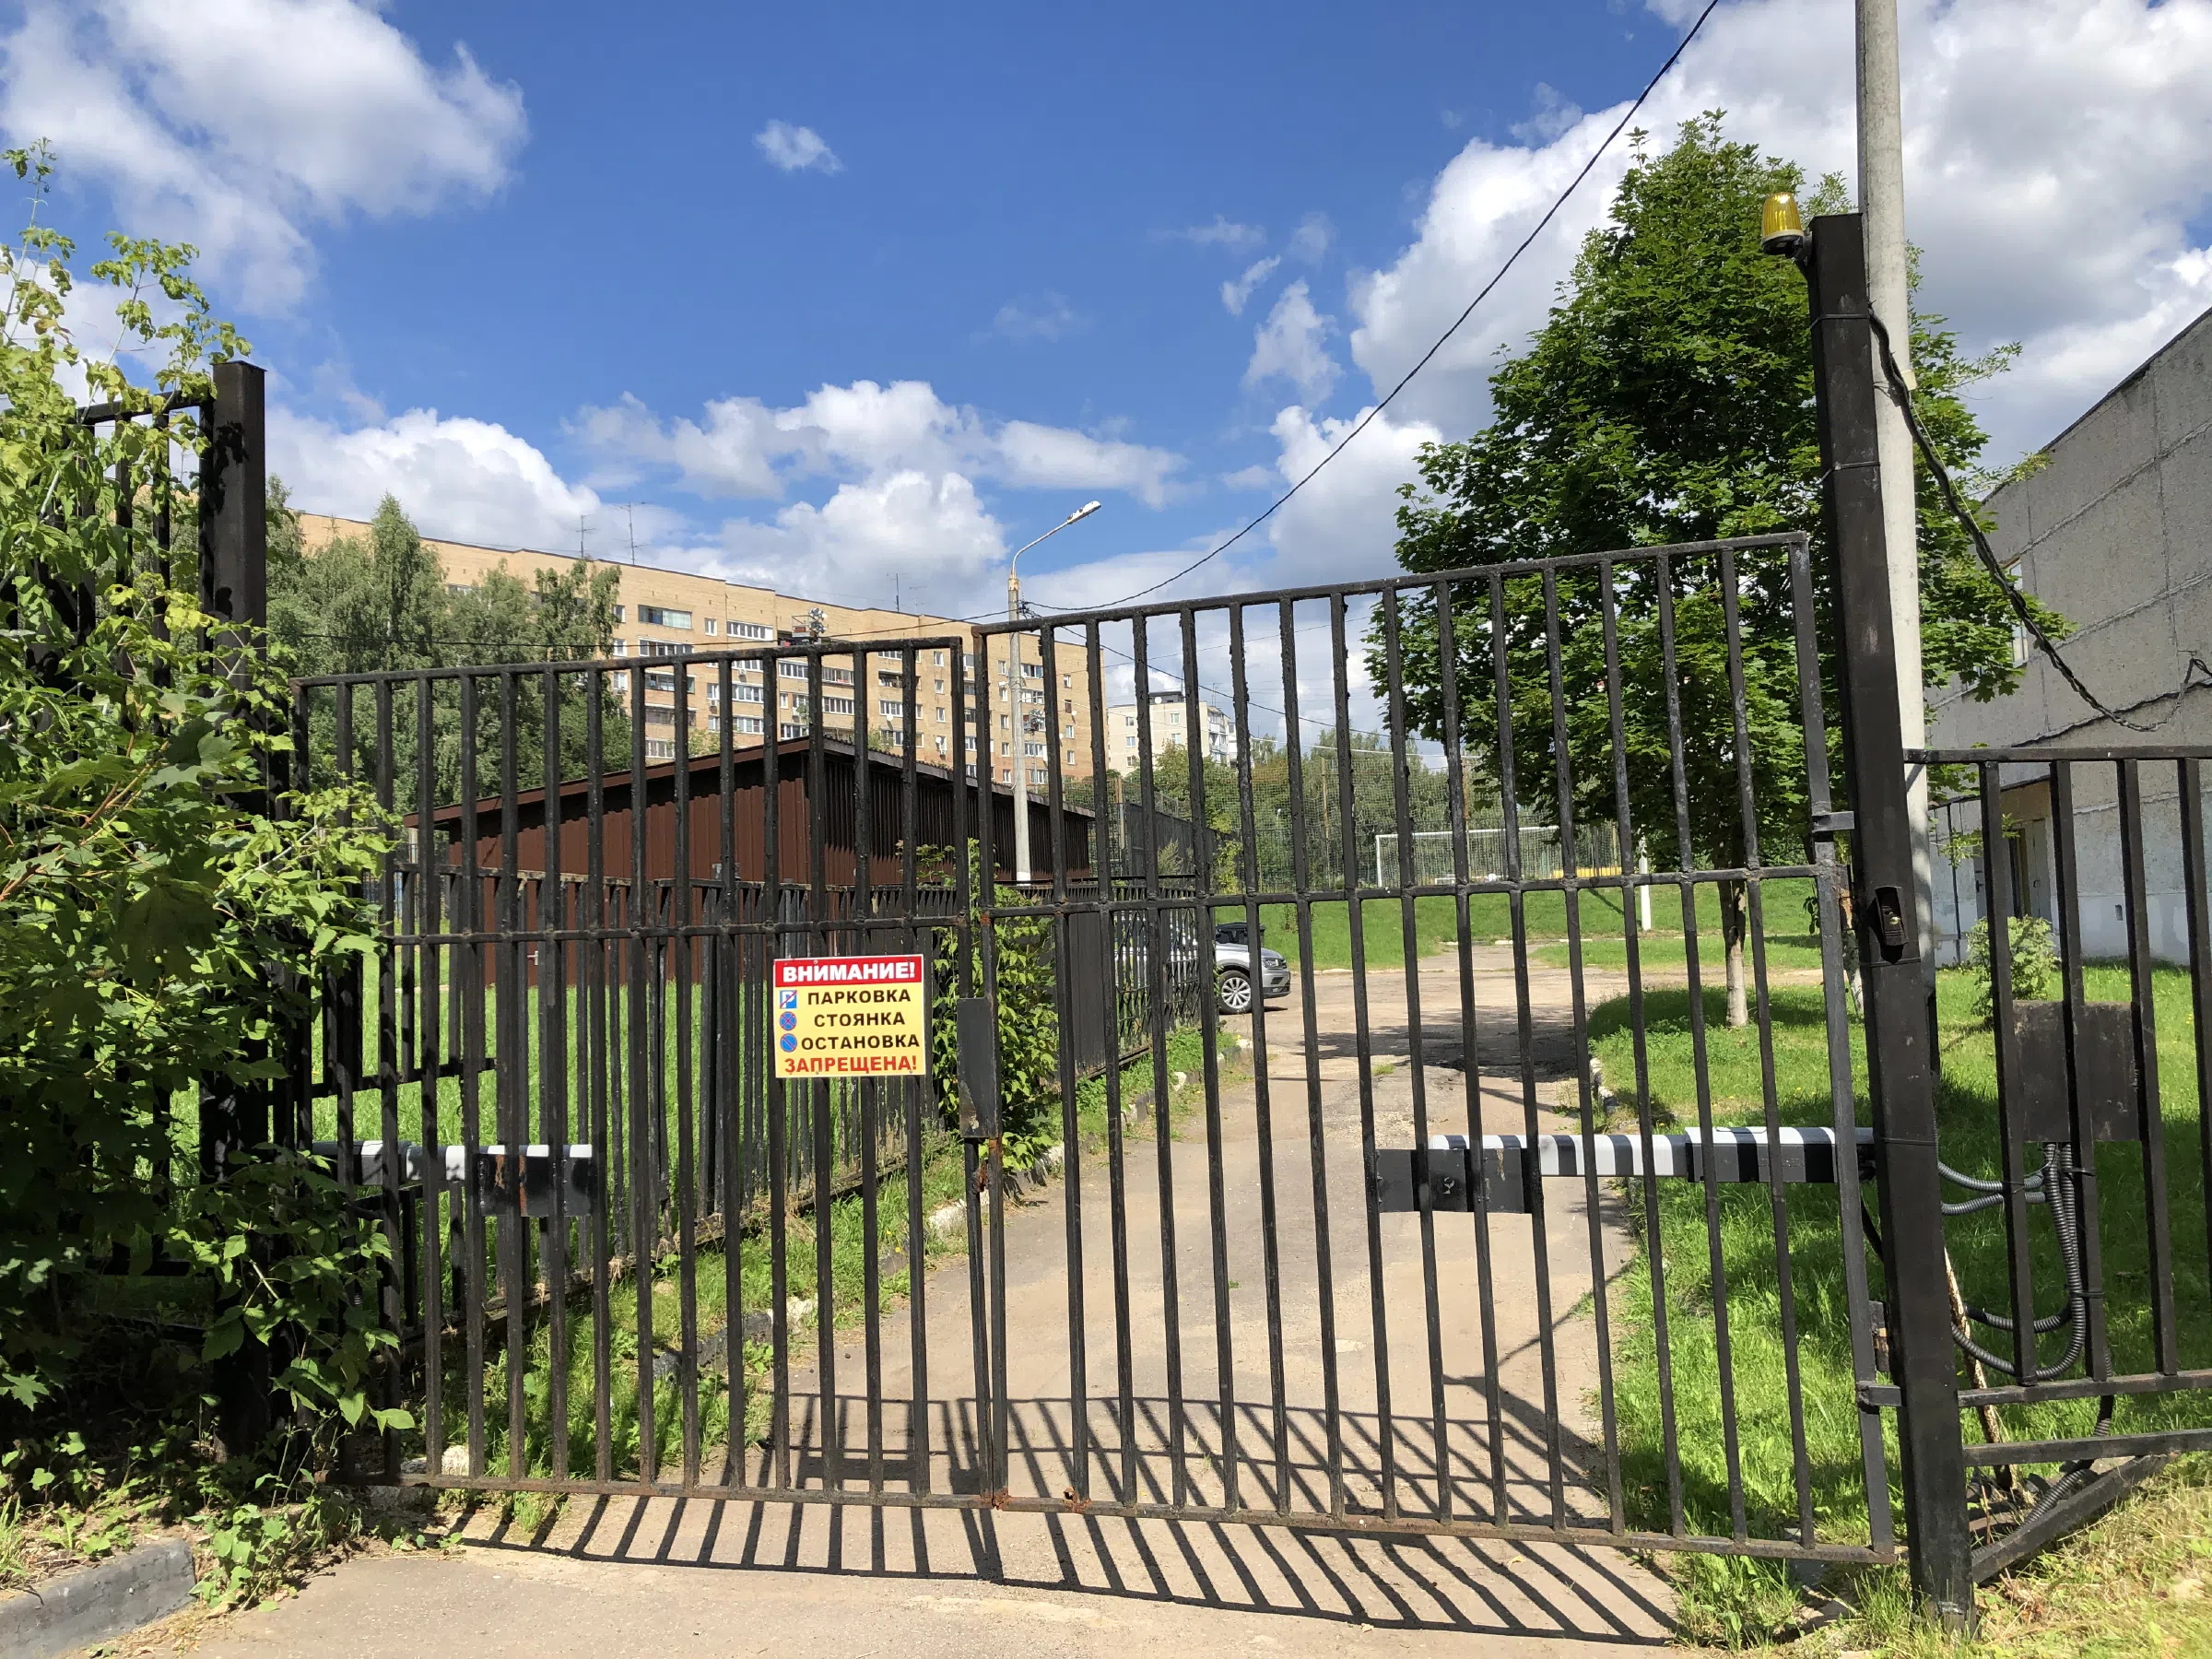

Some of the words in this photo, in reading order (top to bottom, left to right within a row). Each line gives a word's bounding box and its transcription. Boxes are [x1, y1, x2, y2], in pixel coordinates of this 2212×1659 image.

[783, 962, 915, 982] ВНИМАНИЕ!
[807, 989, 911, 1005] ПАРКОВКА
[814, 1012, 905, 1027] СТОЯНКА
[801, 1034, 920, 1051] ОСТАНОВКА
[784, 1055, 917, 1074] ЗАПРЕЩЕНА!
